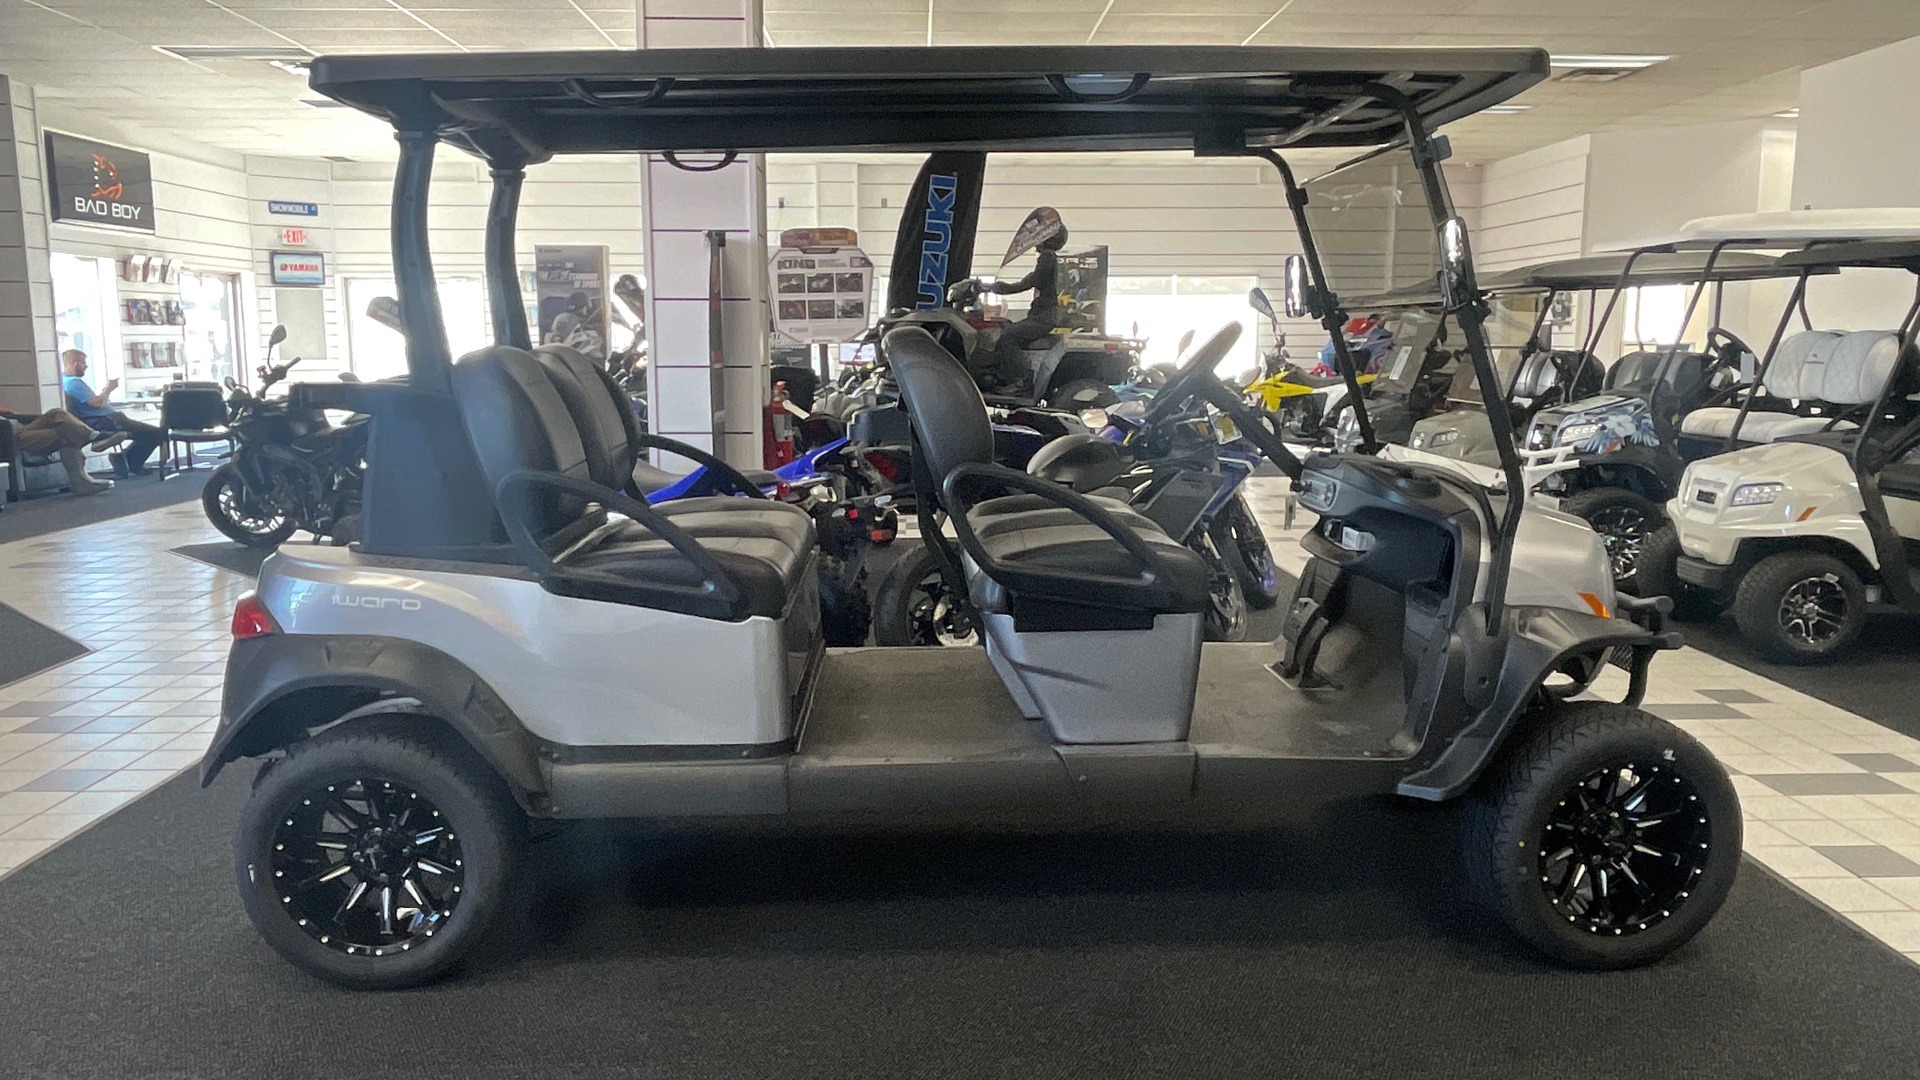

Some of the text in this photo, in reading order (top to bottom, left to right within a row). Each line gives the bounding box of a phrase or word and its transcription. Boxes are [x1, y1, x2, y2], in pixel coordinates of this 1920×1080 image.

[74, 196, 141, 220] BAD BOY
[286, 229, 303, 243] EXIT
[915, 174, 958, 312] UZUKI
[288, 263, 319, 272] YAMAHA
